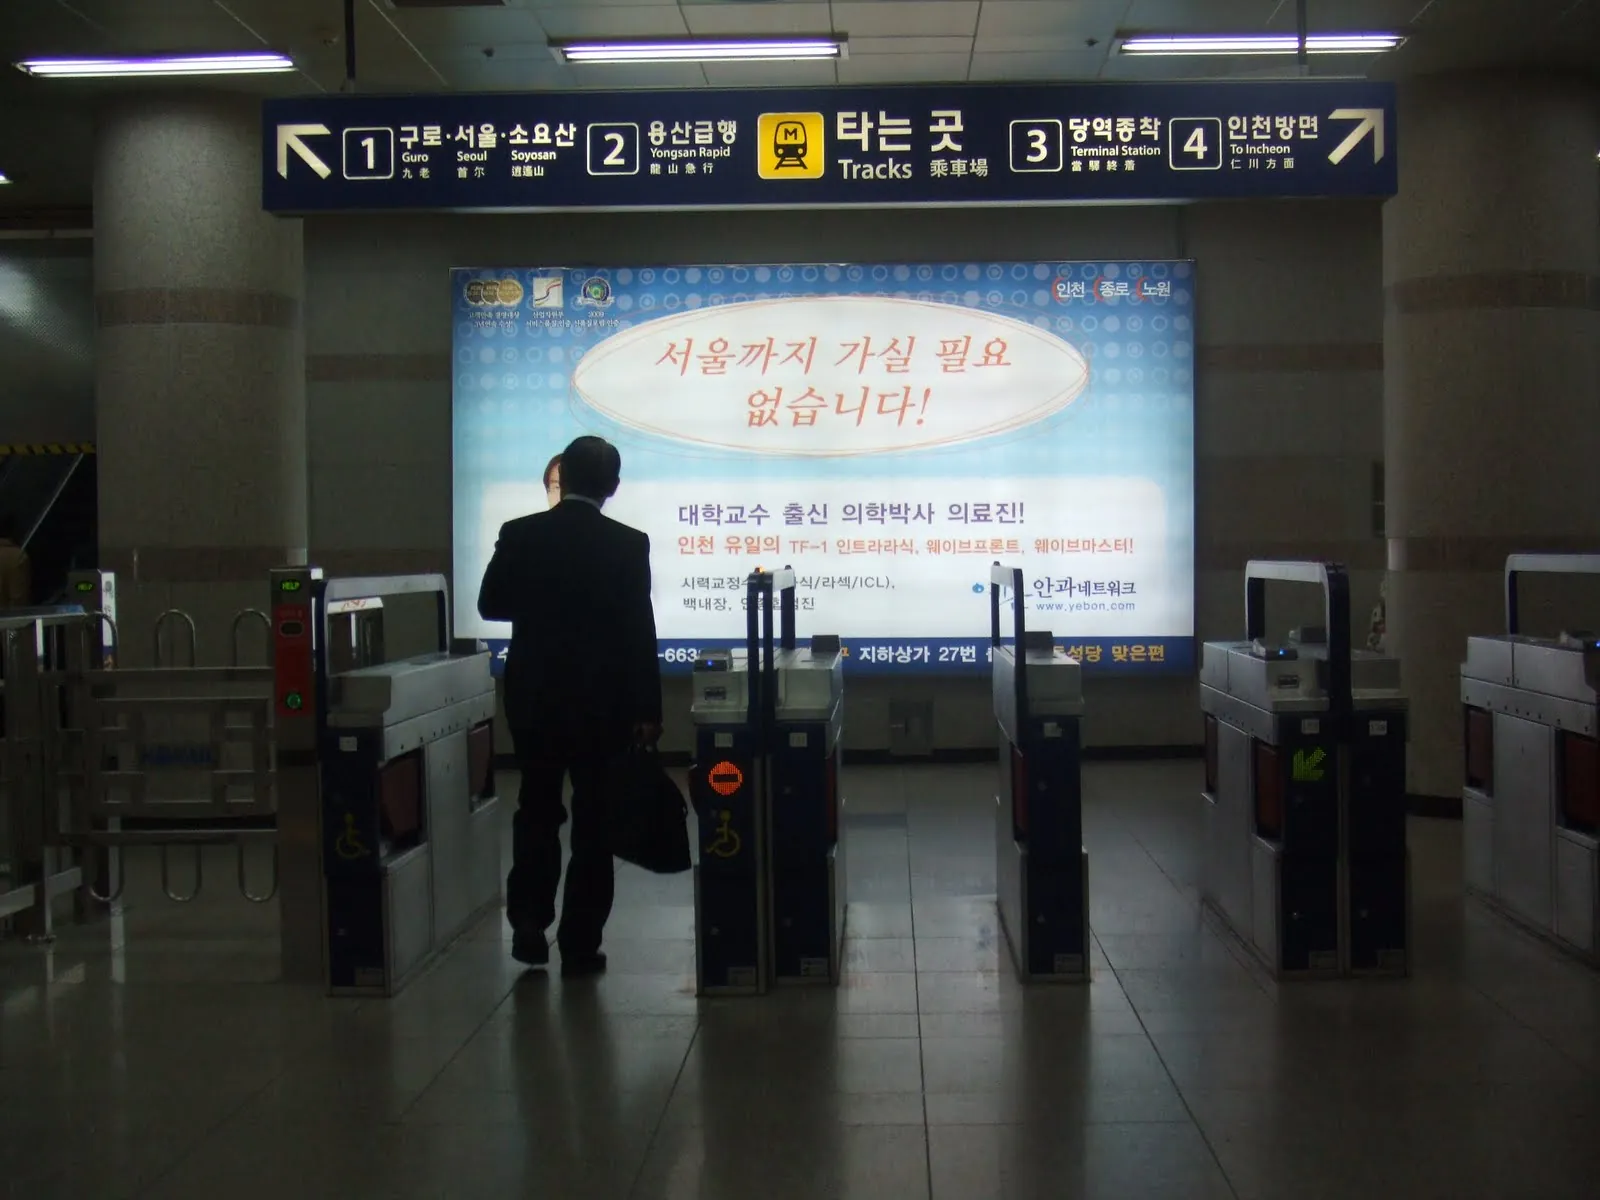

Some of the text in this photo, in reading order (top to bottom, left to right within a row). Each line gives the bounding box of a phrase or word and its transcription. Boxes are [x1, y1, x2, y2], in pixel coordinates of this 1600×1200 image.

[648, 120, 737, 146] 용산급행
[784, 128, 797, 140] M
[837, 110, 964, 152] 타는 곳
[1069, 117, 1161, 143] 당역종착
[1228, 115, 1318, 140] 인천방면
[361, 137, 375, 169] 1
[603, 133, 625, 165] 2
[650, 146, 730, 160] Yongsan Rapid
[1026, 129, 1047, 163] 3
[1071, 144, 1161, 157] Terminal Station
[1183, 128, 1207, 159] 4
[1230, 143, 1290, 154] To Incheon
[402, 149, 557, 163] Guro Seoul Soyosan
[838, 159, 912, 180] Tracks
[930, 158, 989, 178] 乘車場
[1057, 281, 1171, 298] 인천 종로 노원
[655, 335, 1012, 376] 서울까지 가실 필요
[747, 386, 931, 428] 없습니다!
[679, 502, 1025, 526] 대학교수 출신 의학박사 의료진!
[678, 535, 1133, 555] 인천 유일의 TF-1 인트라라식, 웨이브프론트, 웨이브마스터!
[683, 597, 732, 611] 백내장,
[1037, 601, 1135, 612] www.yebon.com
[859, 646, 930, 664] 지하상가
[939, 646, 976, 663] 27번
[1111, 644, 1164, 663] 맞은편
